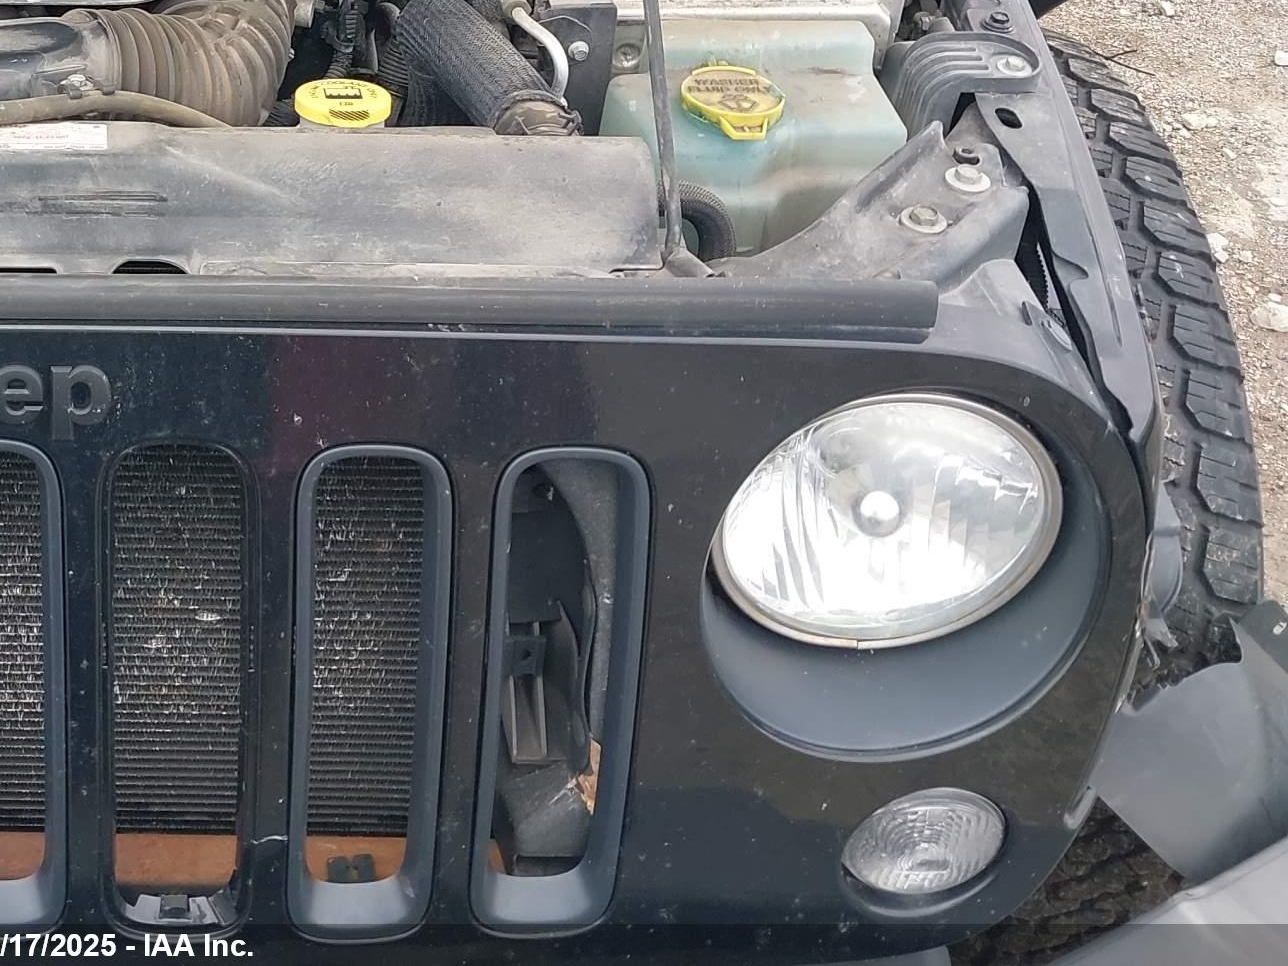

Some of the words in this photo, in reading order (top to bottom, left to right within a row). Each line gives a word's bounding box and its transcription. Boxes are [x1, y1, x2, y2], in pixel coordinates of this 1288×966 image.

[693, 78, 760, 86] WASHER
[687, 85, 730, 93] FLUID
[734, 85, 772, 94] ONLY
